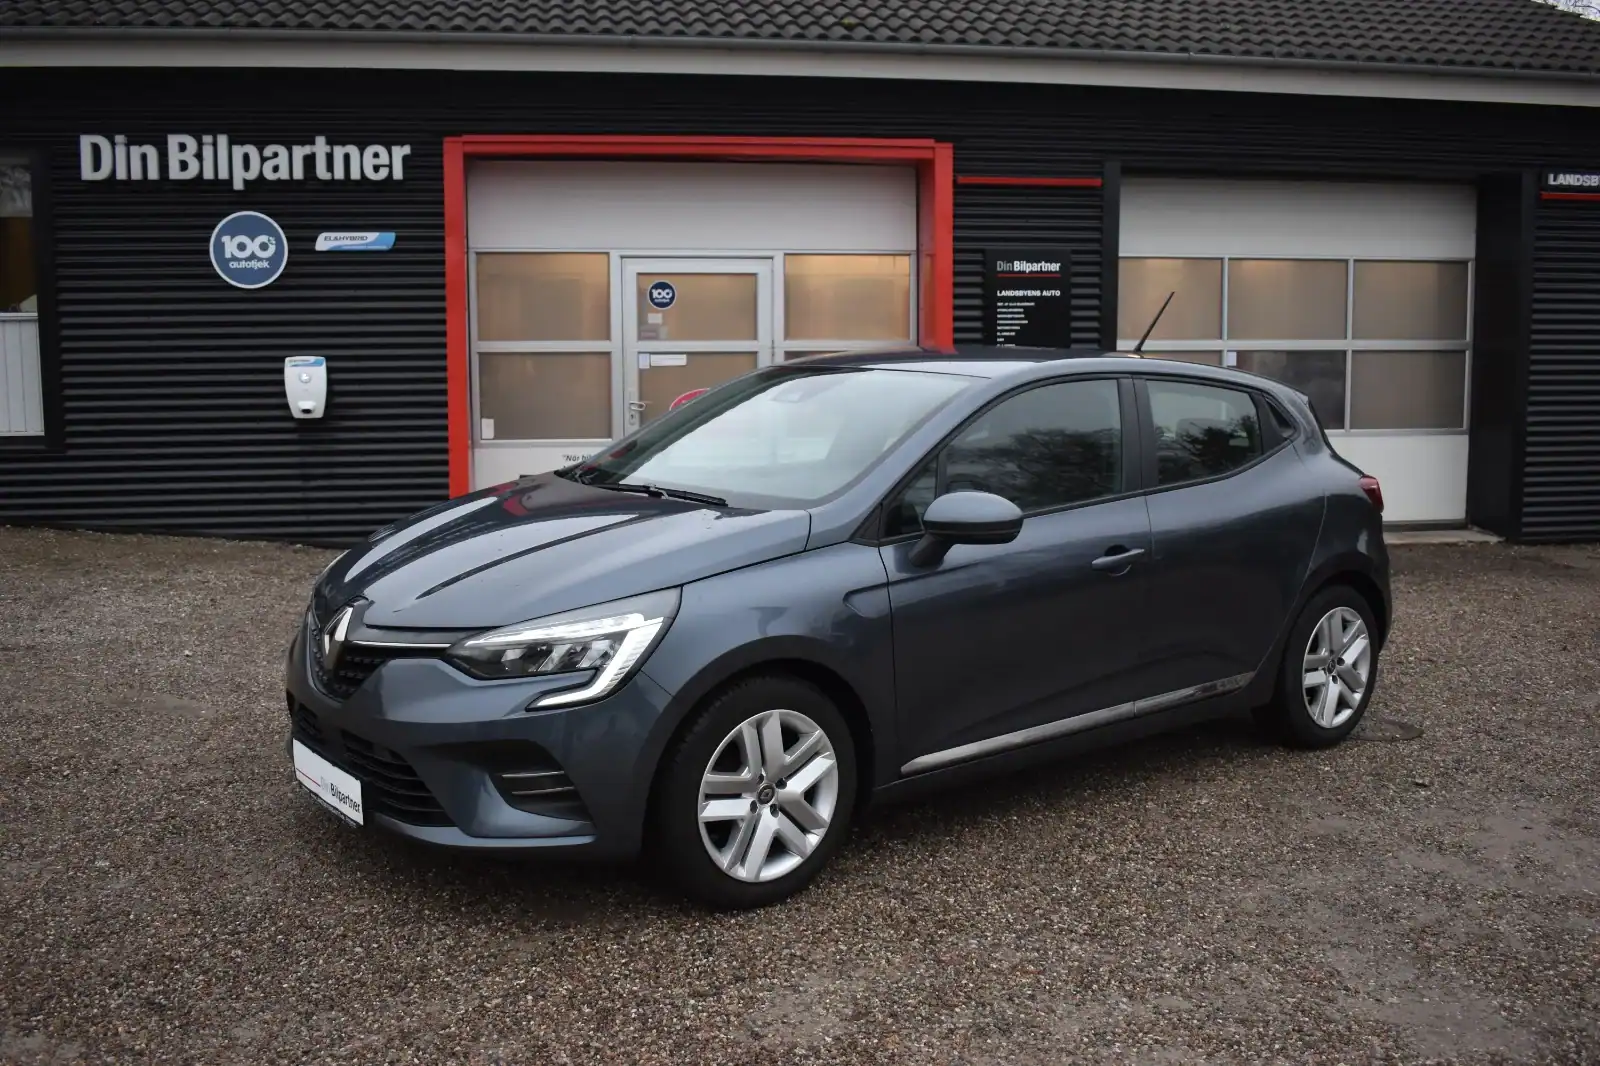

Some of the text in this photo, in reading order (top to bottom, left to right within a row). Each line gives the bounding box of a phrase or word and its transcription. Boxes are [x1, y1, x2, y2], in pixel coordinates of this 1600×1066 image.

[79, 133, 411, 190] Din Bilpartner
[1547, 173, 1600, 187] LANDSB
[229, 259, 270, 270] autotjek
[996, 260, 1061, 273] Din Bilpartner
[996, 289, 1061, 297] LANDSBYENS AUTO
[330, 782, 361, 814] Bilpartner
